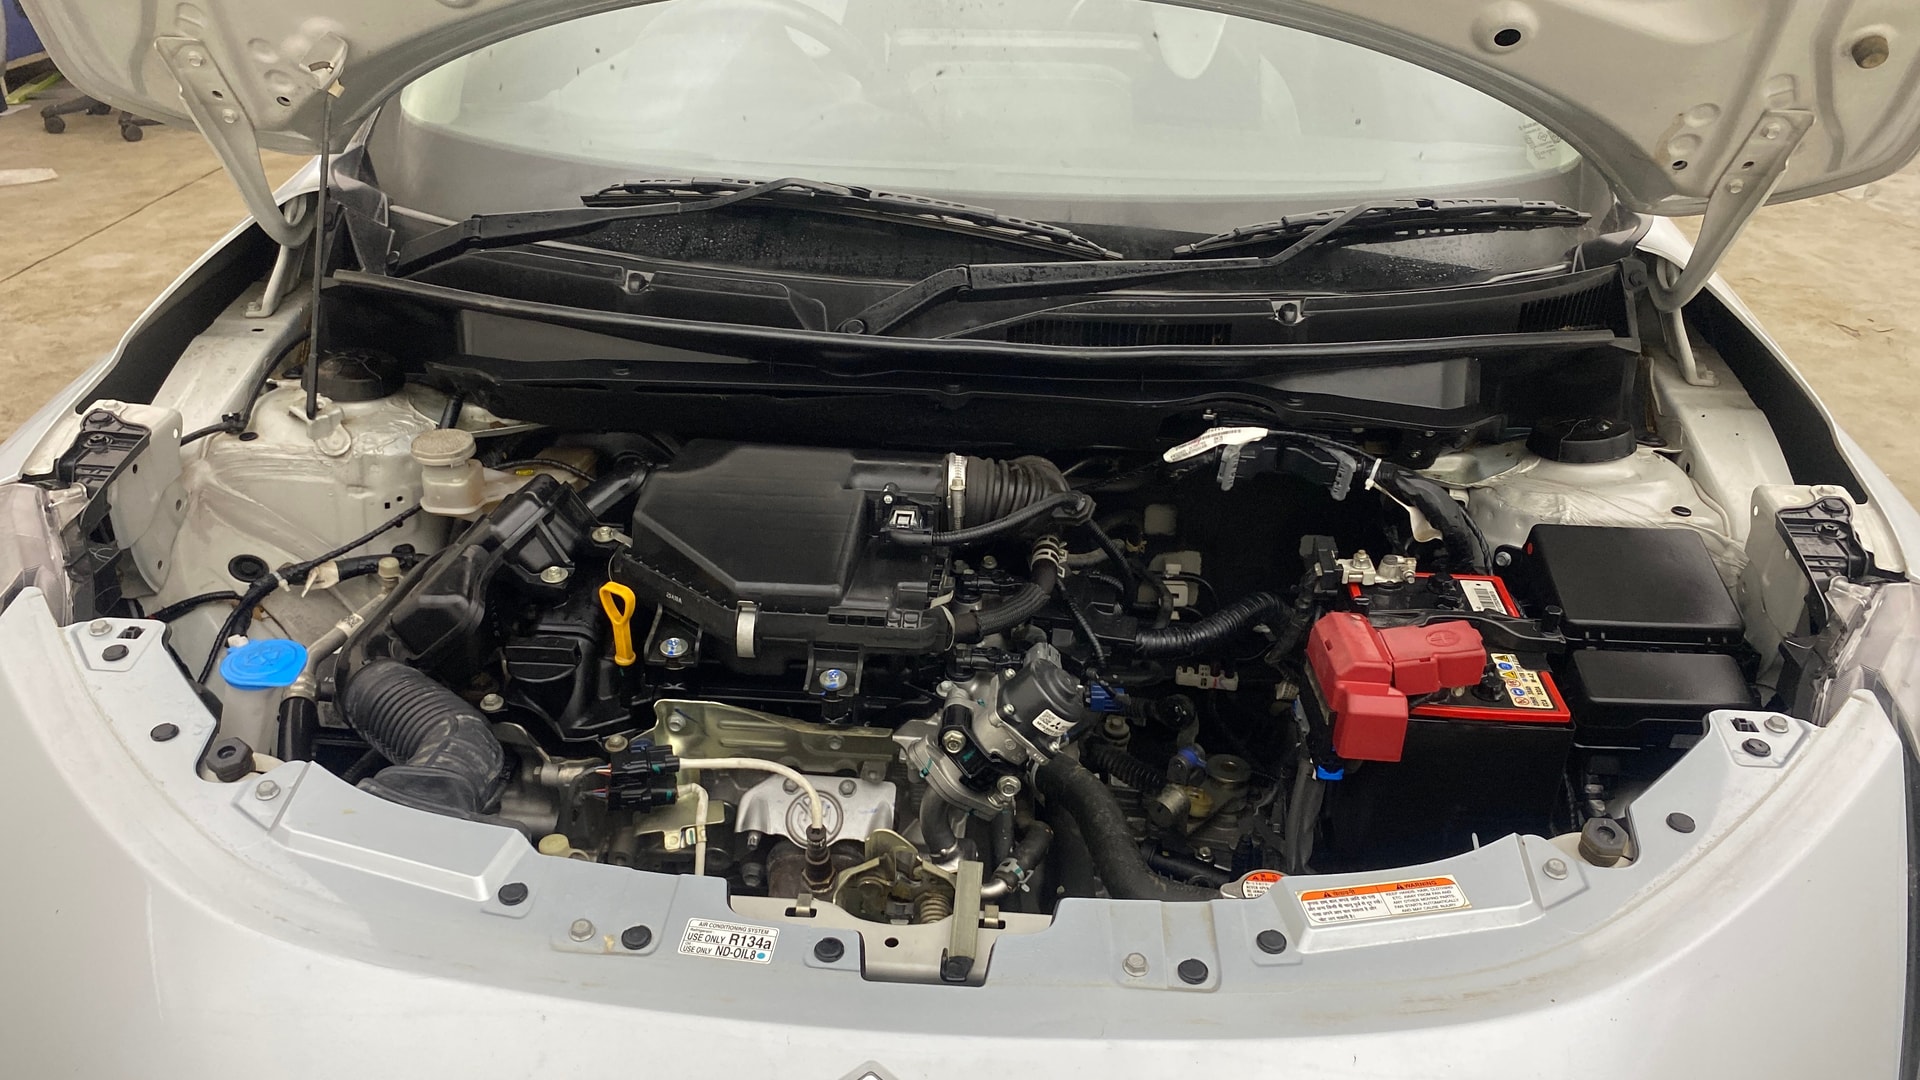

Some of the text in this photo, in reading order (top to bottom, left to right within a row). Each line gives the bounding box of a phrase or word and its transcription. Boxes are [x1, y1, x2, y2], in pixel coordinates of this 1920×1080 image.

[709, 923, 747, 931] CONDITIONING
[687, 933, 772, 949] USE ONLY R134a
[715, 946, 756, 960] ND-OIL8
